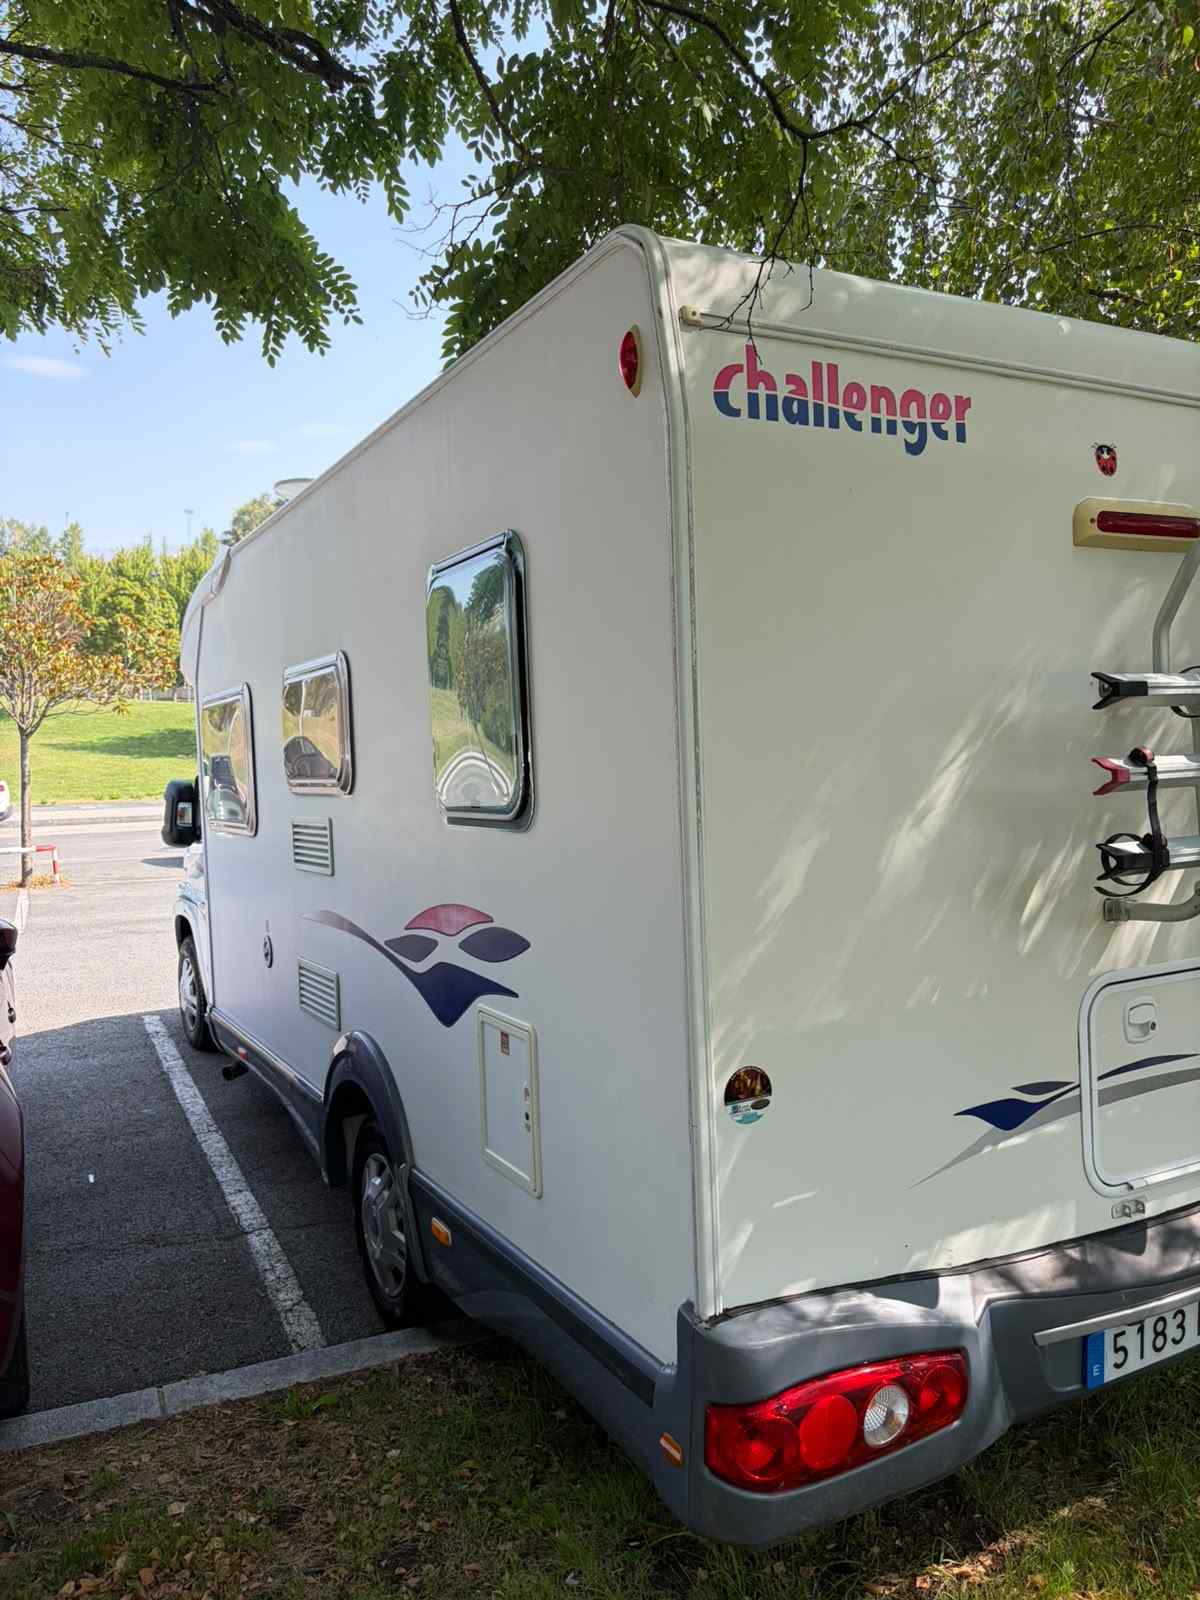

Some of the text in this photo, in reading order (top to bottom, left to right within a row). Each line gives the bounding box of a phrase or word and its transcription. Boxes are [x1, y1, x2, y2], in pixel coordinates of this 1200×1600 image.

[713, 344, 972, 456] challenger
[1112, 1308, 1186, 1370] 5183
[1093, 1364, 1102, 1377] E
